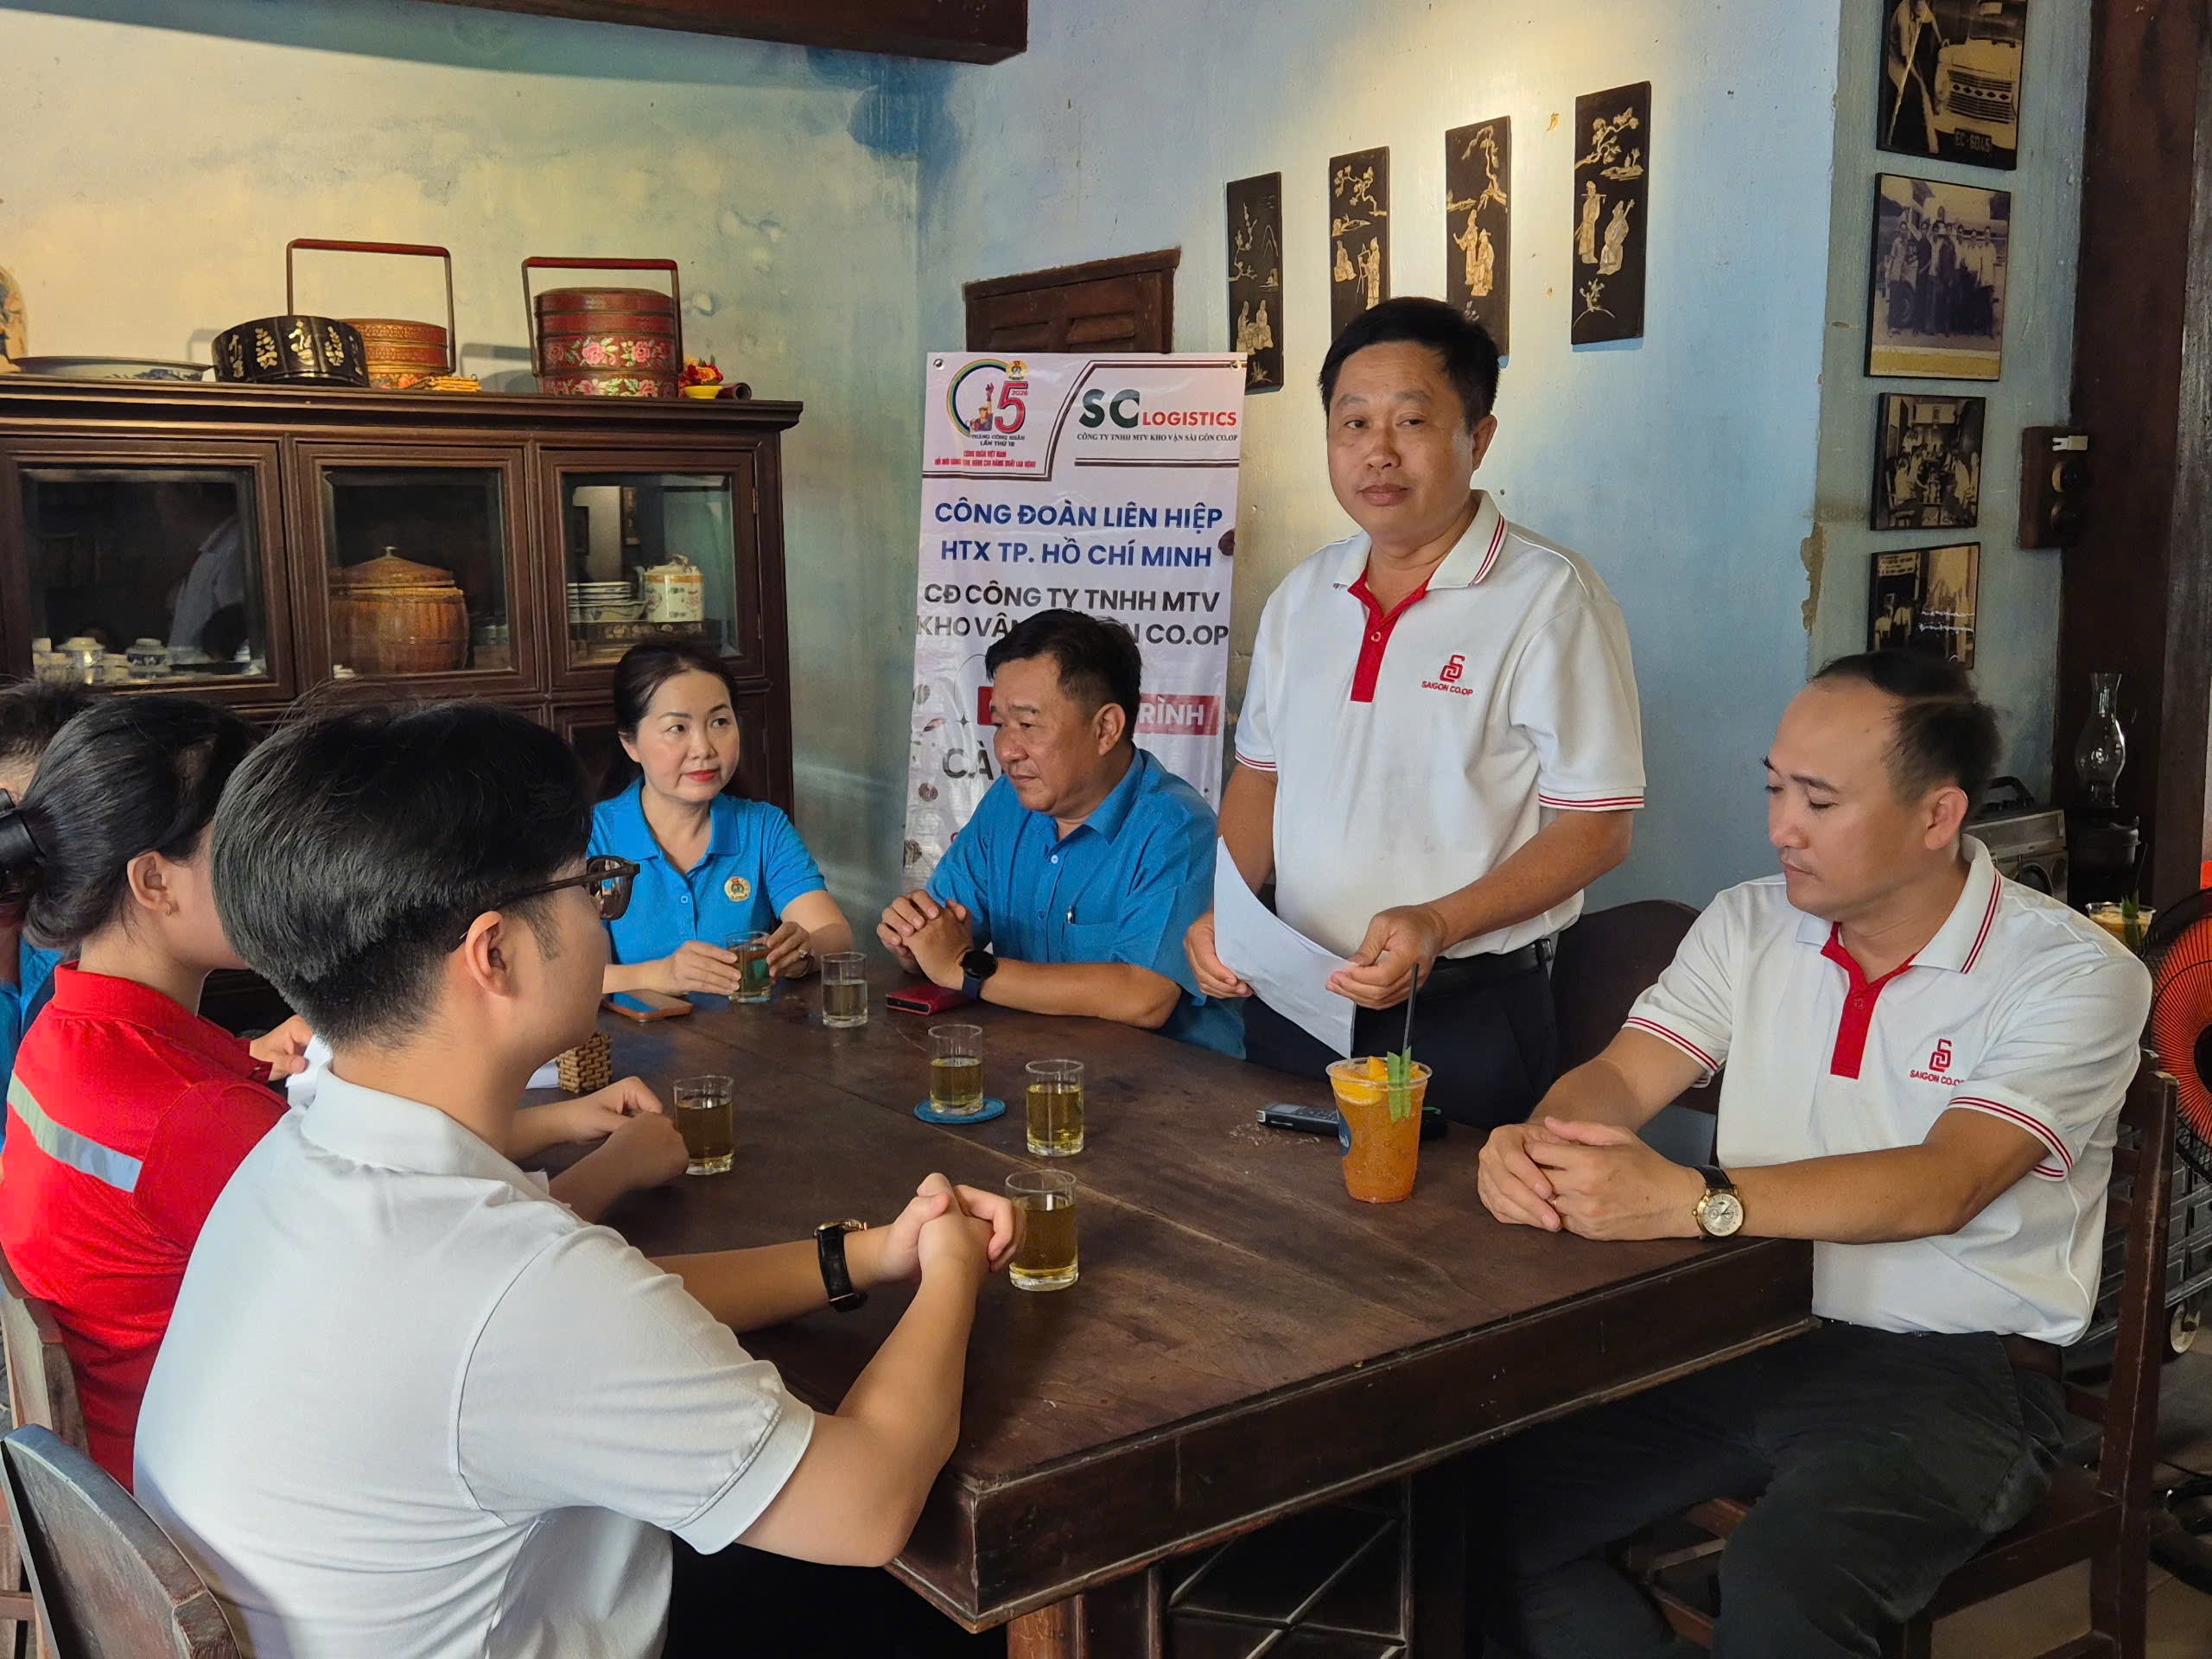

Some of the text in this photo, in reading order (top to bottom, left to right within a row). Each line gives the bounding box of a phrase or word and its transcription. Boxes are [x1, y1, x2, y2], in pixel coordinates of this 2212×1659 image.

[1078, 389, 1237, 429] SC LOGISTICS
[1077, 432, 1098, 442] CÔNG
[1167, 434, 1183, 443] VẬN
[935, 497, 1223, 534] CÔNG ĐOÀN LIÊN HIỆP
[941, 537, 1211, 568] HTX TP. HỒ CHÍ MINH
[924, 580, 1220, 613] CĐ CÔNG TY TNHH MTV
[916, 614, 971, 637] KHO
[1145, 624, 1230, 646] CO.OP
[1421, 680, 1449, 692] SAIGON
[1138, 694, 1205, 726] RÌNH
[942, 740, 995, 781] CÀ
[1910, 1069, 1940, 1084] SAIGON
